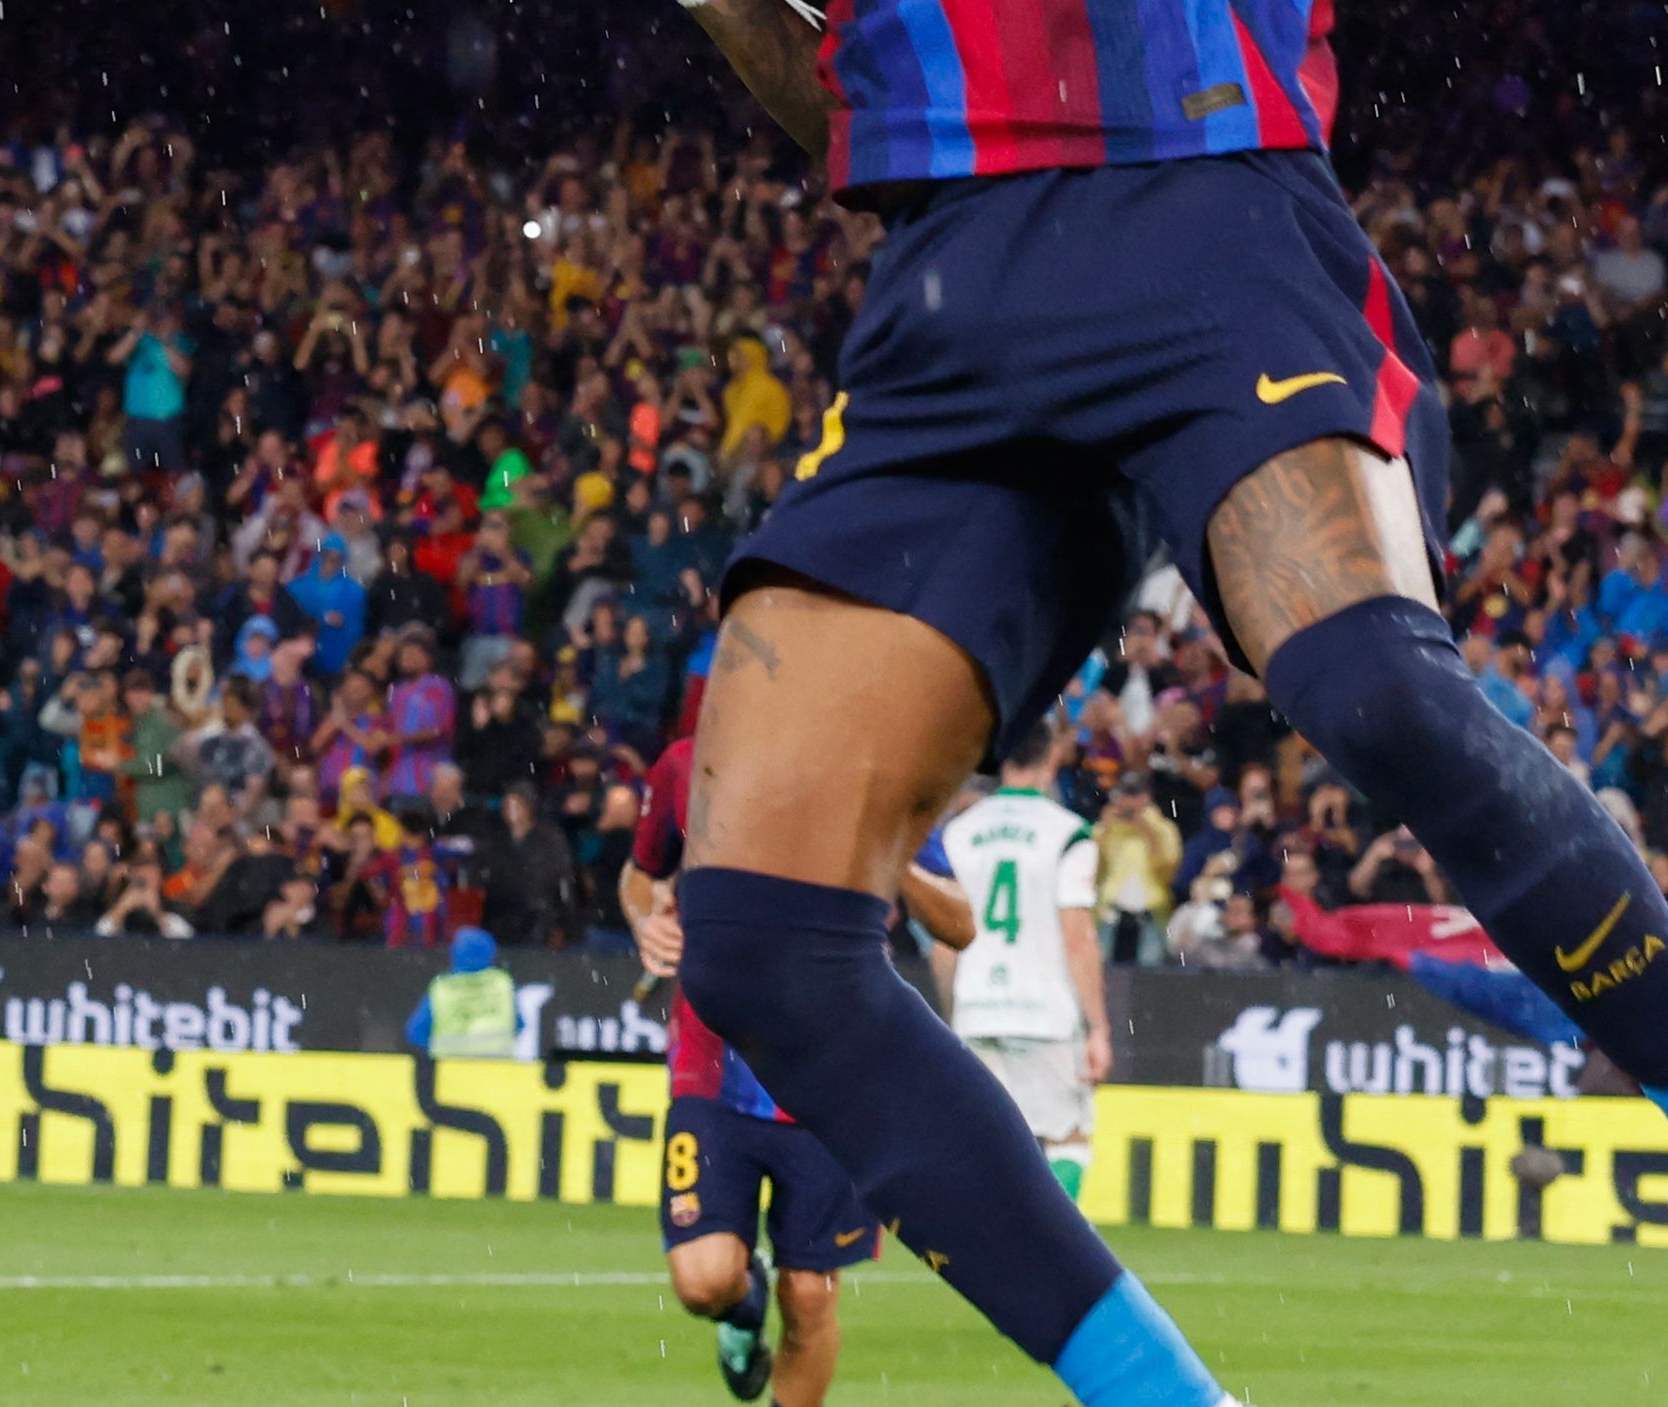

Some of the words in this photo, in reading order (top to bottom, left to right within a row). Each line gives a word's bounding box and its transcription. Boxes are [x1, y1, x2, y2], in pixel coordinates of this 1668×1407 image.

[984, 859, 1020, 944] 4
[1570, 934, 1666, 1003] BARÇA
[5, 981, 302, 1053] whitebit
[667, 1131, 700, 1190] 8
